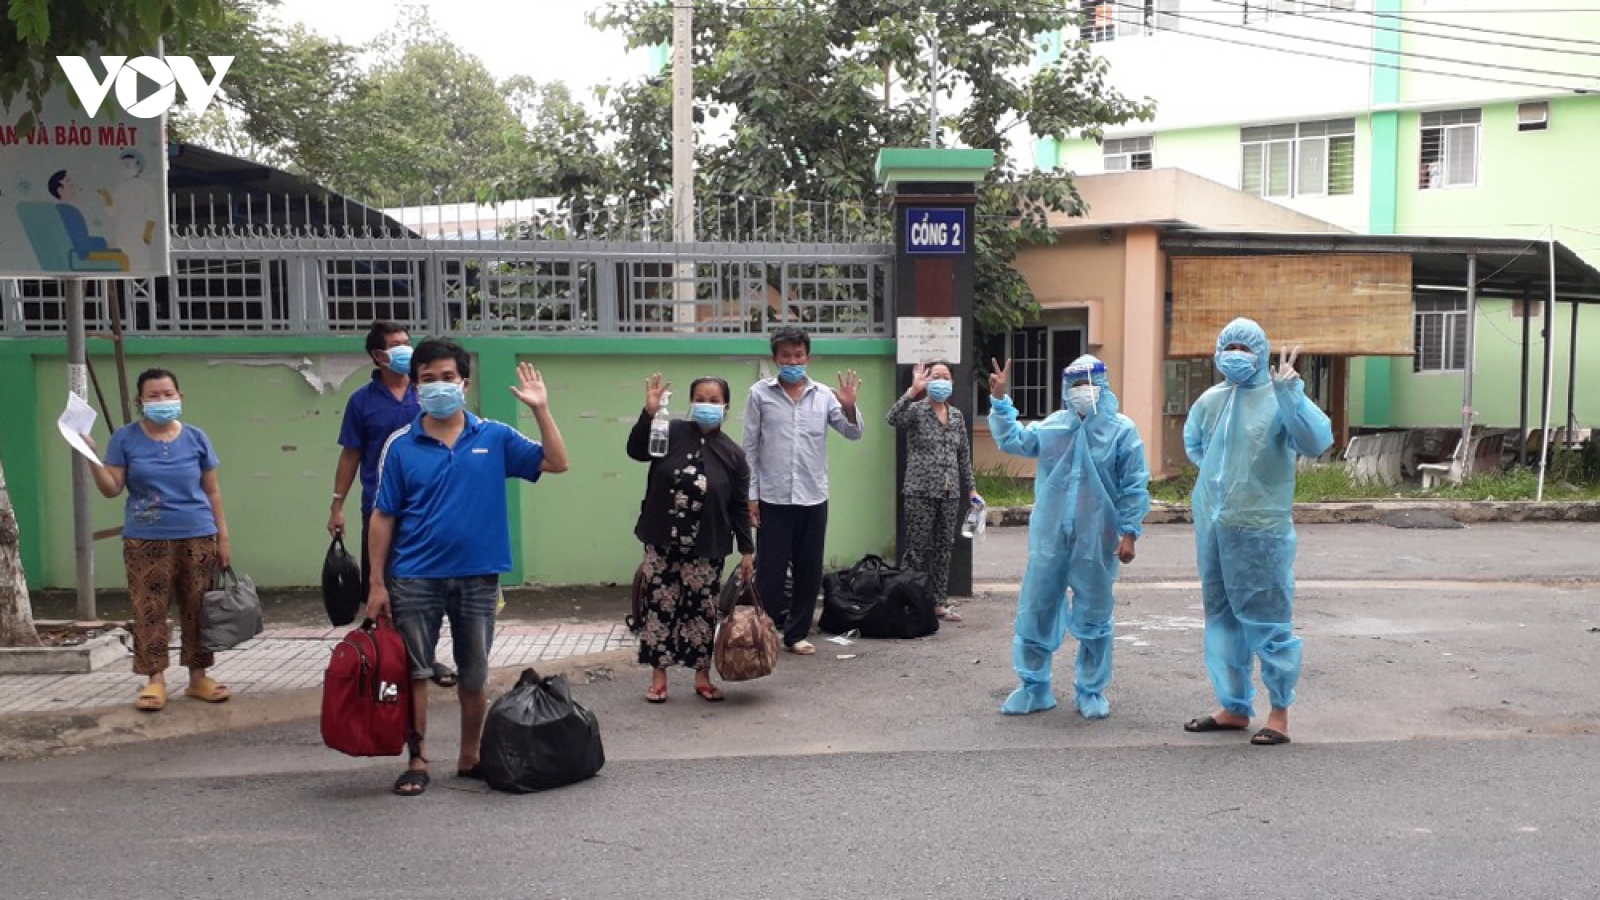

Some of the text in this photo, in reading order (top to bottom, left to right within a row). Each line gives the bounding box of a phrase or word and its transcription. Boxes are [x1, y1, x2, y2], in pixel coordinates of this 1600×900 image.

[55, 120, 92, 146] BẢO
[98, 122, 137, 150] MẬT
[911, 212, 961, 246] CỔNG 2
